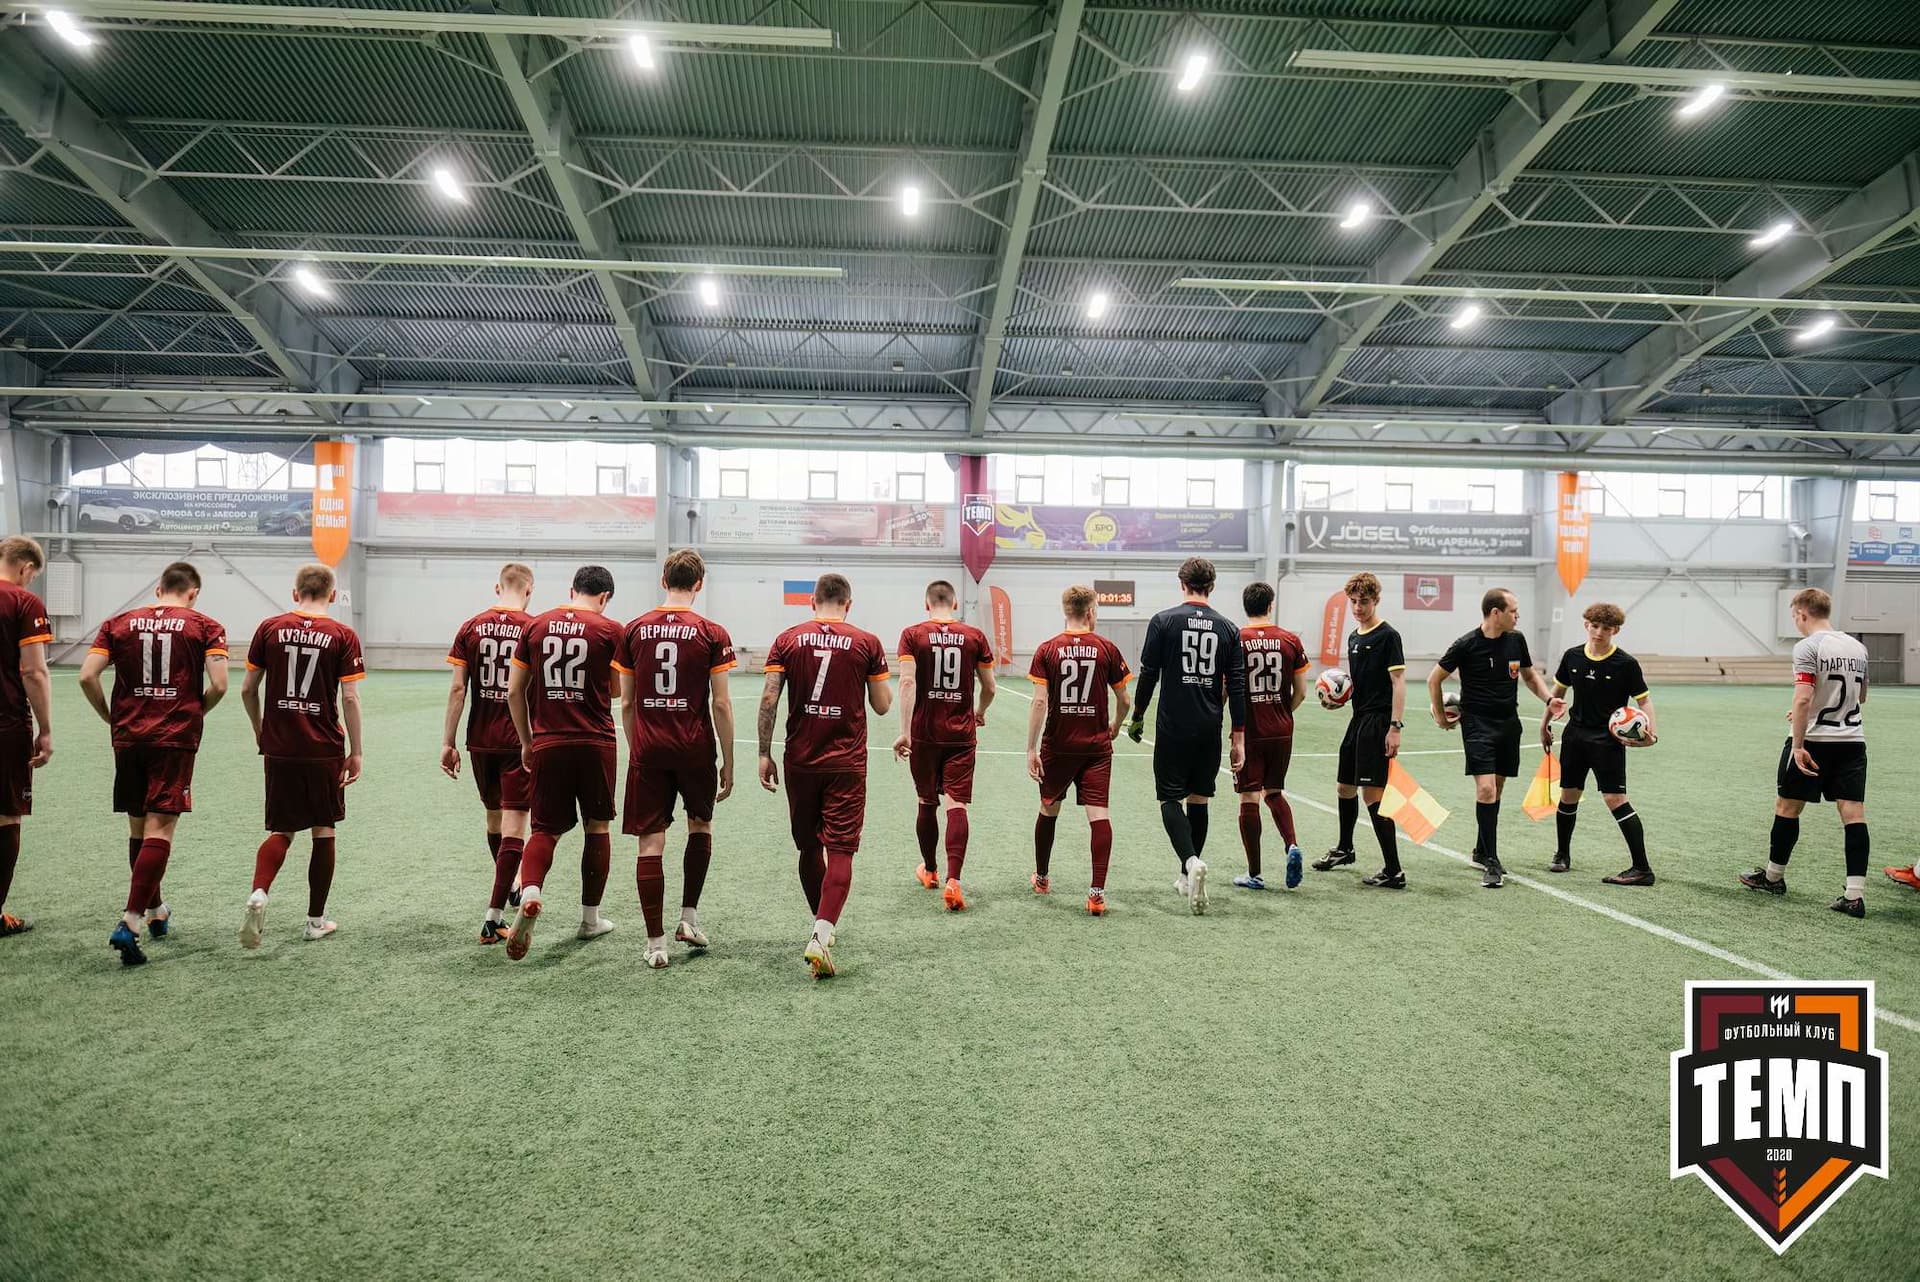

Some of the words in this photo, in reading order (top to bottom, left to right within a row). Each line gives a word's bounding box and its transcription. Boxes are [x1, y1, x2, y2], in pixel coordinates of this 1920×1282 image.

[133, 491, 213, 501] ЭКСКЛЮЗИВНОЕ
[214, 492, 289, 502] ПРЕДЛОЖЕНИЕ
[1330, 521, 1409, 541] JÖGEL
[1409, 525, 1470, 537] Футбольная
[1471, 526, 1530, 537] экипировка
[1413, 537, 1436, 547] ТРЦ
[1491, 538, 1498, 546] 3
[129, 618, 185, 632] РОДИЧЕВ
[548, 620, 586, 636] БАБИЧ
[1187, 617, 1213, 630] ПАНОВ
[277, 628, 333, 648] КУЗЬКИН
[640, 624, 698, 640] ВЕРНИГОР
[928, 632, 965, 646] ШИБАЕВ
[796, 632, 853, 651] ТРОЦЕНКО
[1245, 639, 1281, 652] ВОРОНА
[139, 632, 172, 685] 11
[1057, 645, 1098, 659] ЖДАНОВ
[1182, 629, 1218, 675] 59
[480, 637, 518, 688] 33
[542, 635, 588, 689] 22
[655, 641, 678, 695] 3
[932, 645, 961, 690] 19
[284, 644, 321, 699] 17
[811, 649, 832, 702] 7
[1247, 652, 1282, 693] 23
[1060, 659, 1096, 703] 27
[1182, 675, 1213, 686] SEUS
[134, 687, 178, 697] SEUS
[547, 690, 585, 701] SEUS
[928, 691, 962, 700] SEUS
[1250, 694, 1281, 703] SEUS
[277, 700, 321, 712] SEUS
[643, 698, 688, 708] SEUS
[1815, 674, 1862, 727] 22
[1060, 705, 1096, 714] SEUS
